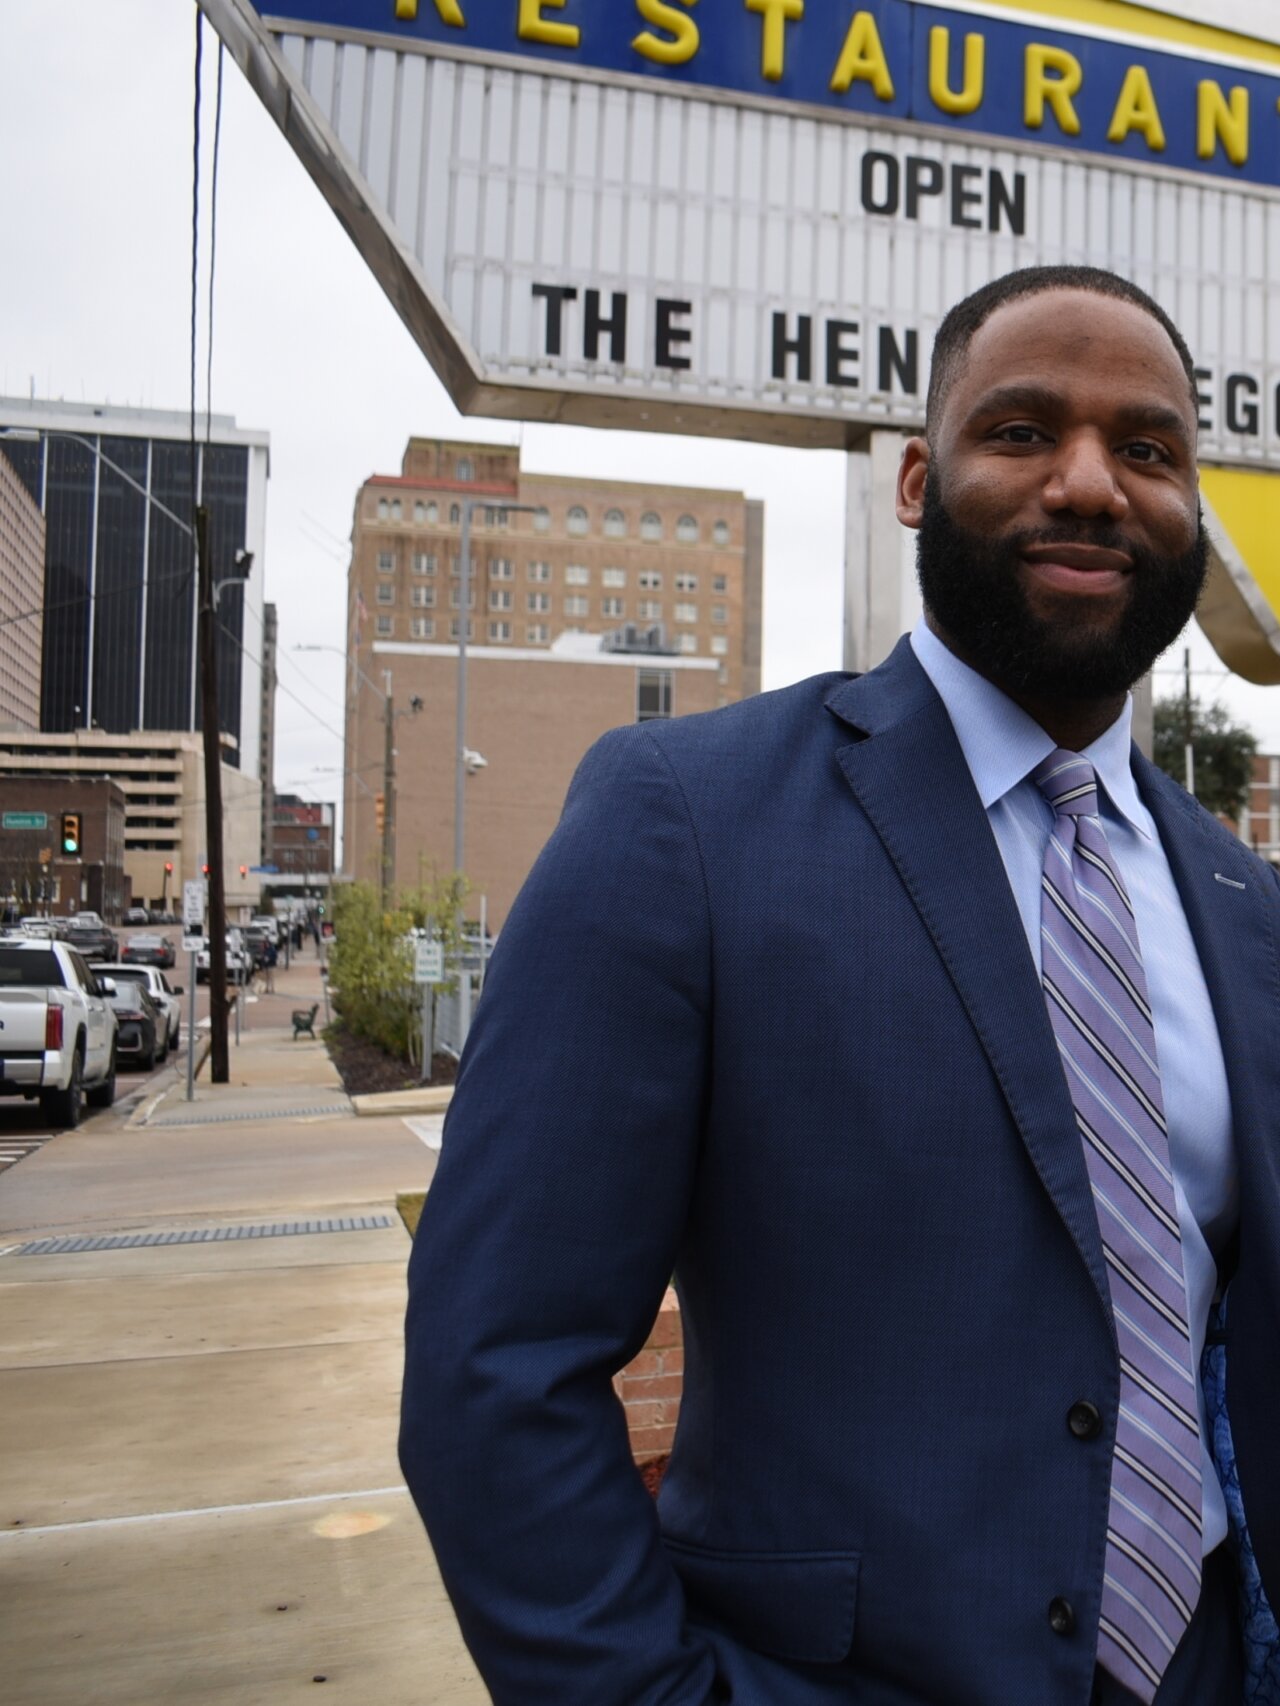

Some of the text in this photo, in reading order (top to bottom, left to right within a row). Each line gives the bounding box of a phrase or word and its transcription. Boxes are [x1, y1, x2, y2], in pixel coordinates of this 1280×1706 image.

[861, 151, 1025, 236] OPEN
[532, 283, 692, 370] THE
[772, 311, 917, 394] HEN
